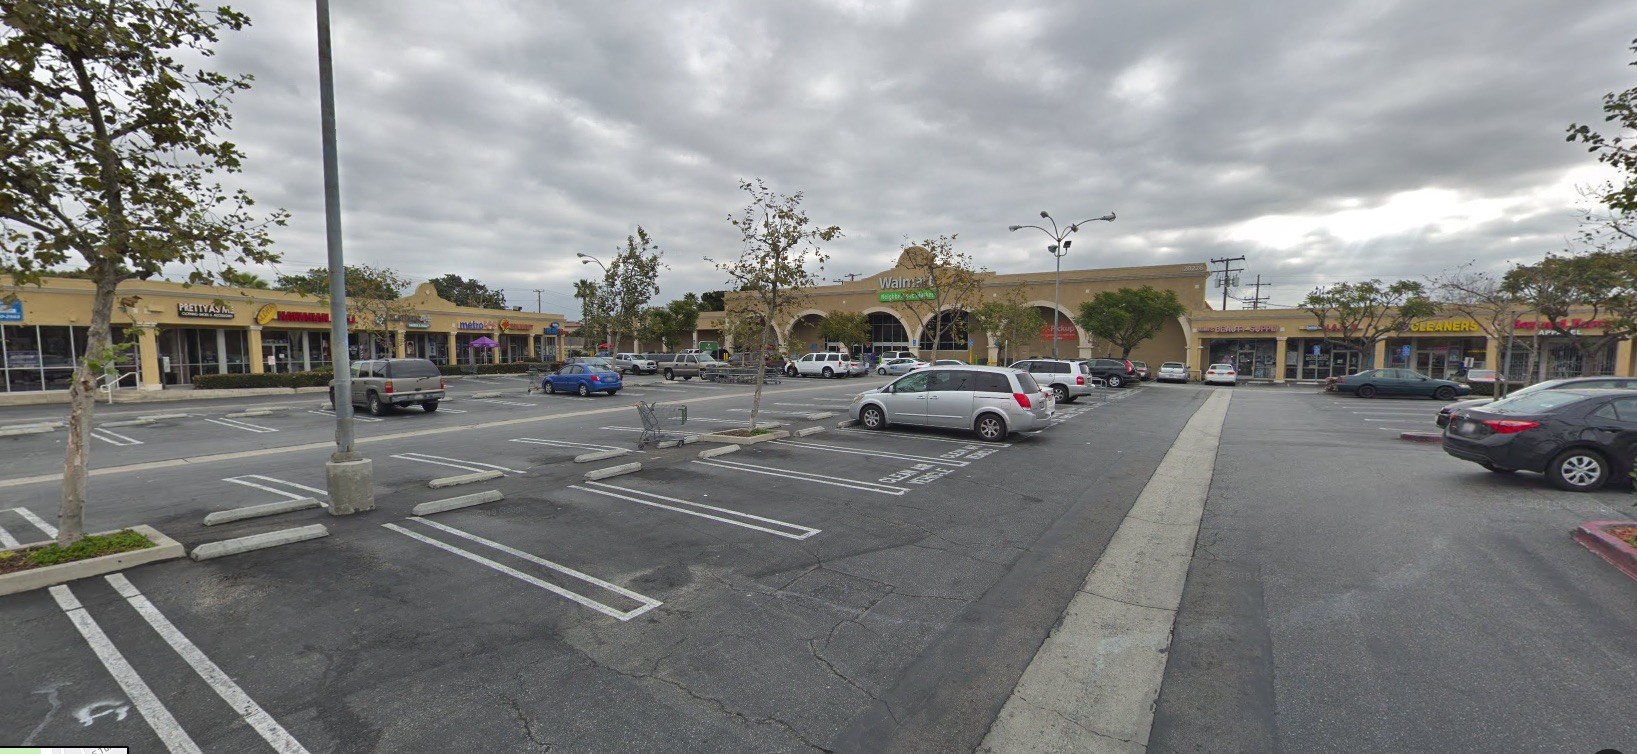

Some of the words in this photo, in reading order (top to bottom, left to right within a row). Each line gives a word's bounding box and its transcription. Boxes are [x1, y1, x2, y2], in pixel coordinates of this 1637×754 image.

[179, 303, 208, 313] PRETTY
[1050, 325, 1075, 333] Pckup
[1411, 320, 1479, 332] CLEANERS
